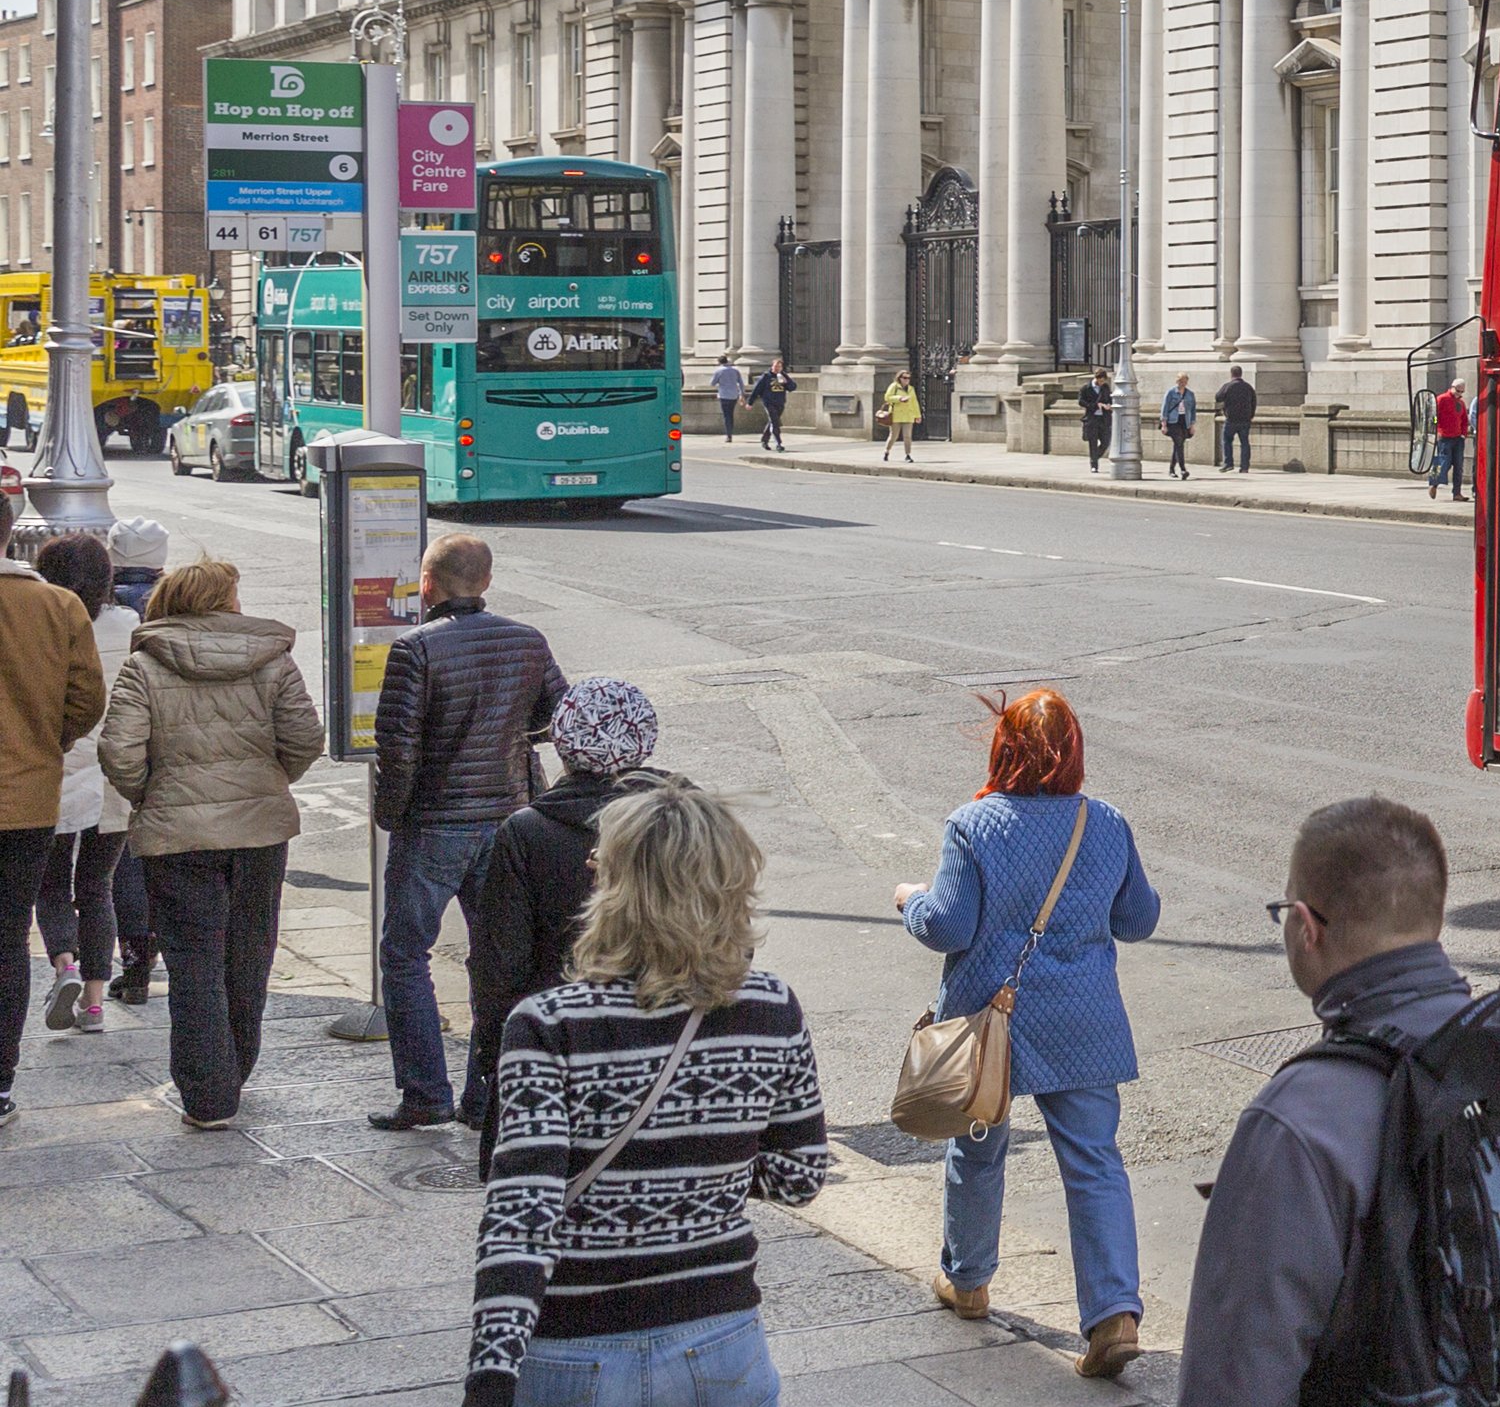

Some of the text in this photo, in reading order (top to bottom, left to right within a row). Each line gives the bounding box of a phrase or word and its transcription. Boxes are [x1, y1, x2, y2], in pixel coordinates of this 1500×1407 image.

[214, 102, 355, 121] Hop on Hop off
[242, 131, 329, 143] Merrion Street
[412, 149, 444, 165] City
[339, 162, 349, 173] 6
[412, 164, 467, 178] Centre
[239, 186, 333, 197] Merrion Street Upper
[412, 179, 448, 192] Fare
[216, 227, 239, 240] 44
[258, 227, 278, 240] 61
[290, 228, 322, 242] 757
[415, 244, 459, 265] 757
[408, 271, 470, 283] AIRLINK
[408, 284, 456, 294] EXPRESS
[486, 293, 580, 312] city airport
[618, 301, 630, 310] 10
[631, 302, 654, 311] mins
[409, 311, 469, 321] Set Down
[425, 322, 454, 335] Only
[565, 335, 620, 351] Airlink
[557, 426, 609, 435] Dublin Bus
